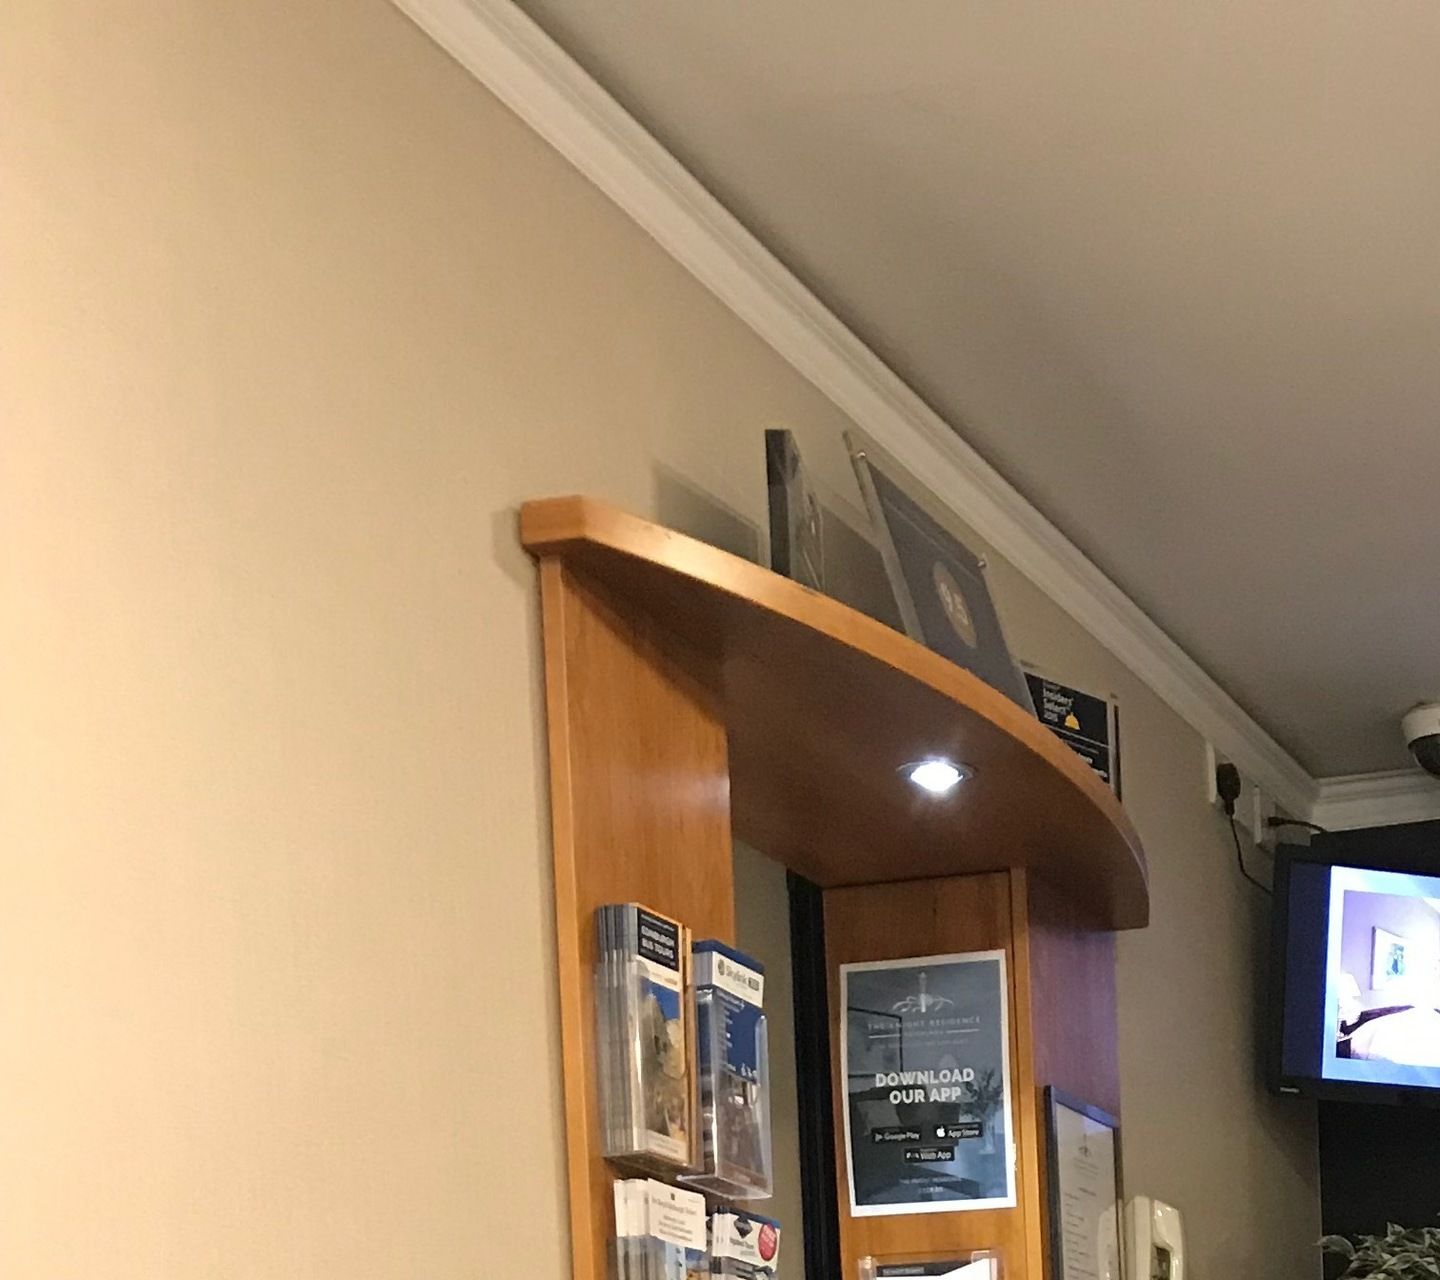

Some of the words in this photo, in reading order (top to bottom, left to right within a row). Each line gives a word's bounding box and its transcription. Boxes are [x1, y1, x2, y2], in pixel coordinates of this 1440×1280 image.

[875, 1067, 975, 1088] DOWNLOAD
[889, 1088, 926, 1105] OUR
[929, 1086, 962, 1103] APP
